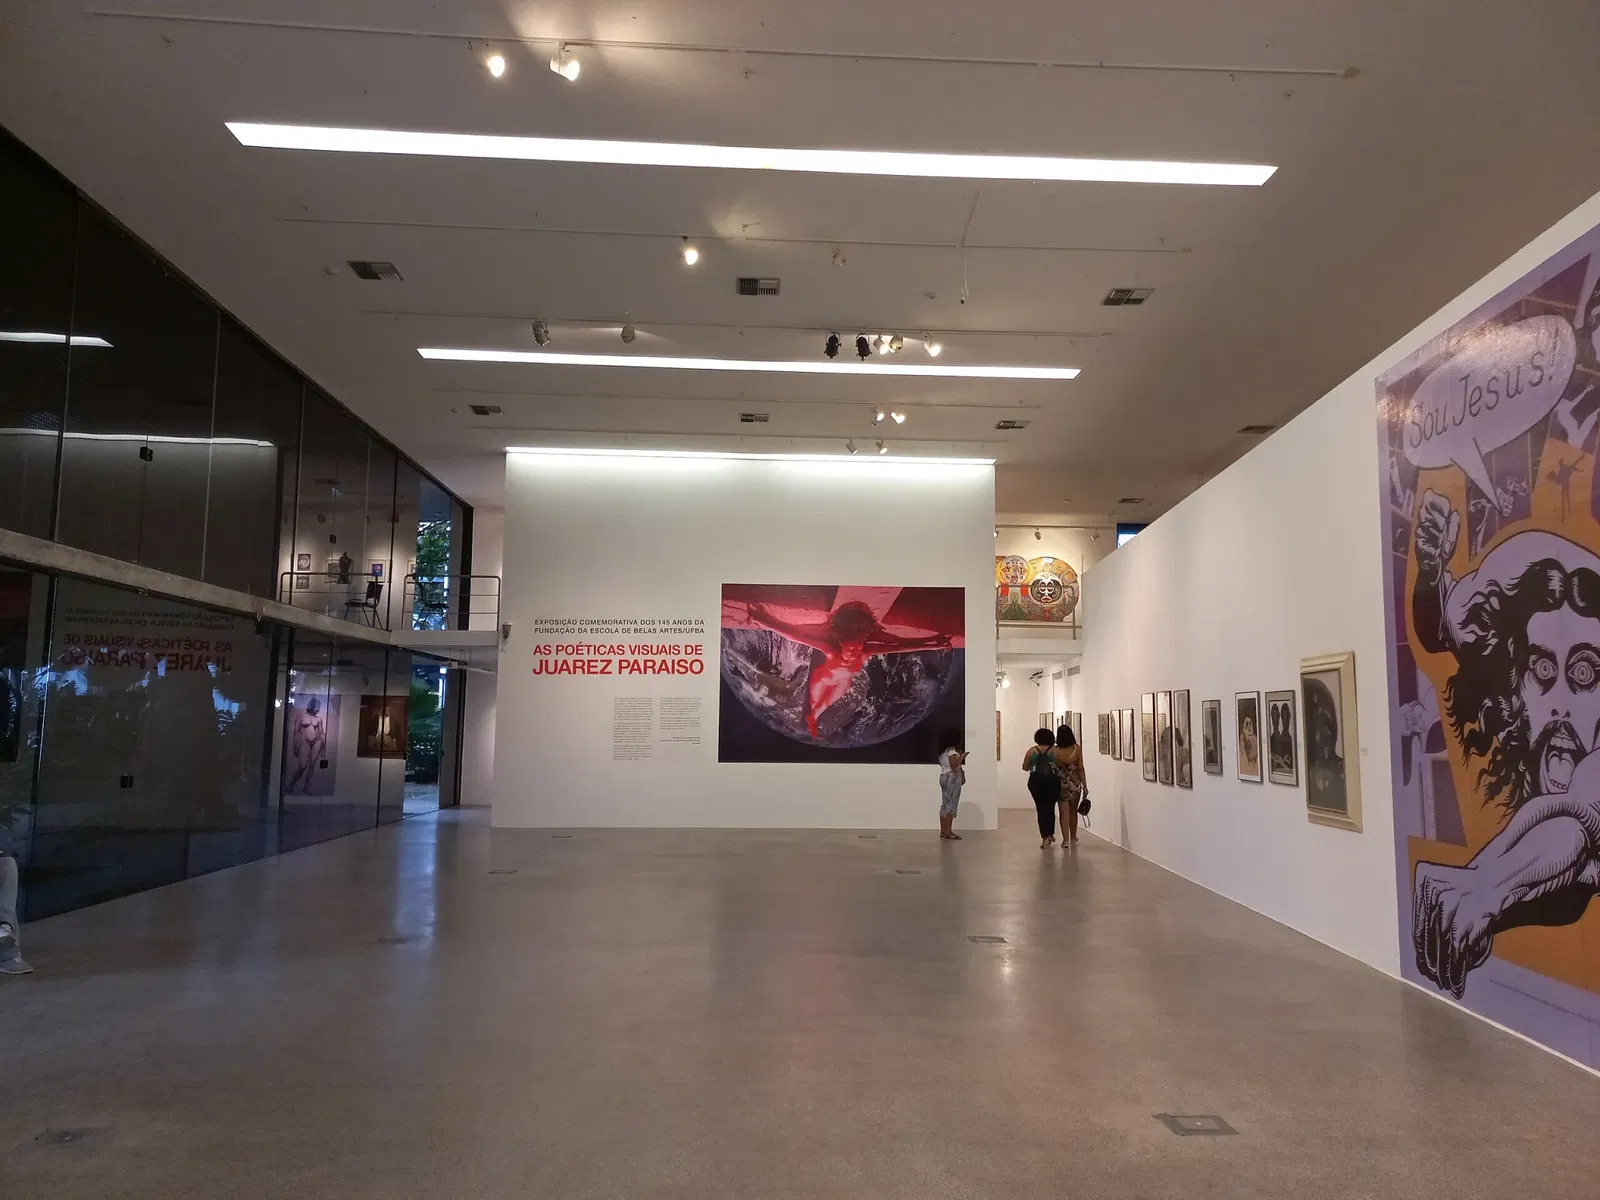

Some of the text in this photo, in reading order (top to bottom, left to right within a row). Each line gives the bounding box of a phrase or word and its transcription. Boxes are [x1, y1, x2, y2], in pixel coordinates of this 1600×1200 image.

[1410, 327, 1560, 448] Sou Jesus!
[534, 618, 578, 626] EXPOSIÇÃO
[534, 626, 576, 635] FUNDAÇÃO
[533, 641, 703, 656] AS POÉTICAS VISUAIS DE
[532, 658, 704, 675] JUAREZ PARAISO
